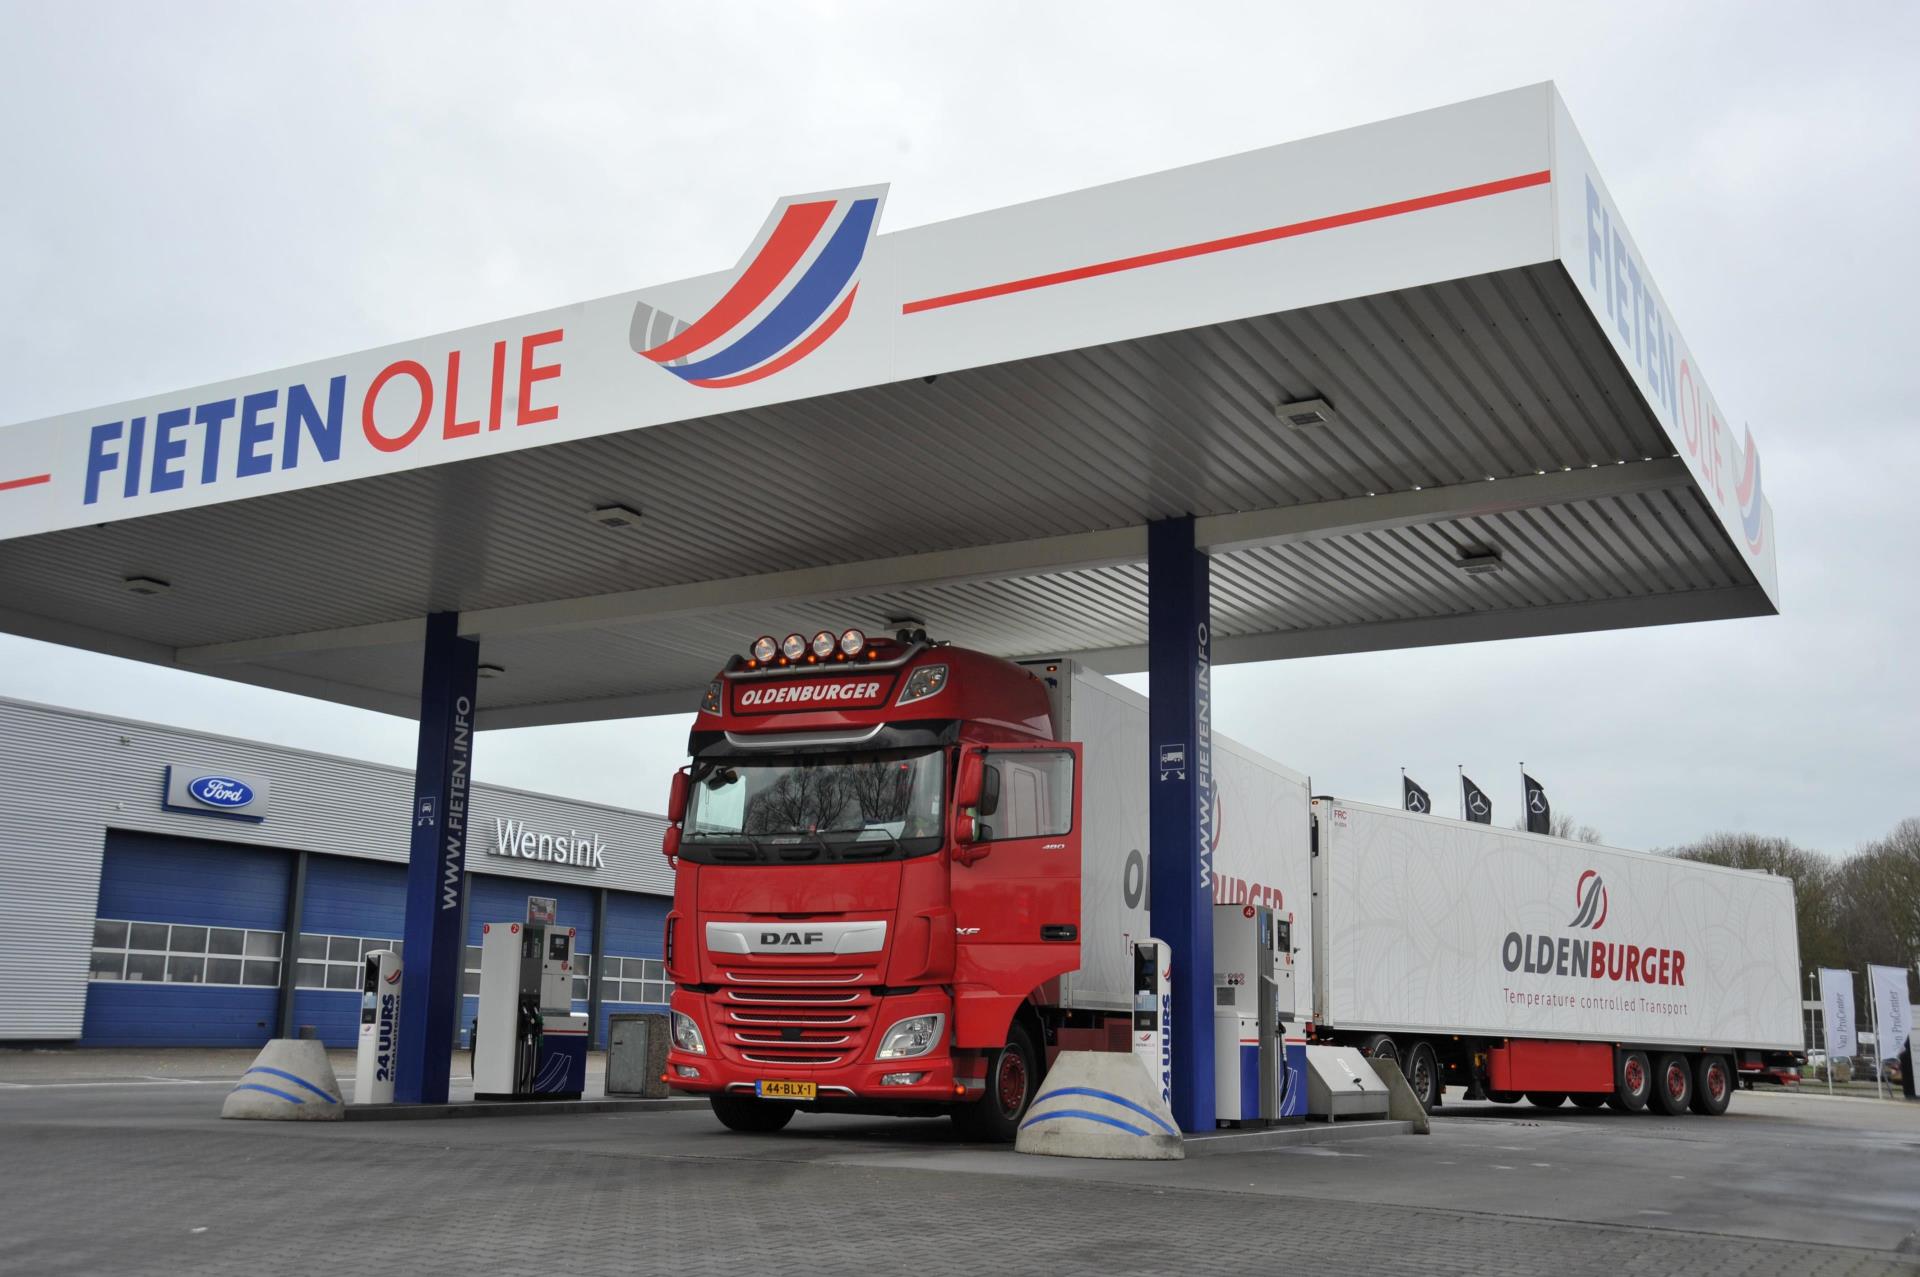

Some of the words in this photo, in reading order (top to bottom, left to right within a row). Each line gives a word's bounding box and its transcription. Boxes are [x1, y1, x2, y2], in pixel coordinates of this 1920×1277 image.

[741, 682, 880, 706] OLDENBURGER
[203, 779, 243, 802] Ford
[442, 696, 470, 909] WWW.FIETEN.INFO
[1334, 809, 1348, 820] FRC
[497, 818, 606, 868] Wensink
[760, 932, 823, 945] DAF
[956, 927, 980, 935] XF
[1502, 931, 1685, 987] OLDENBURGER
[1503, 988, 1576, 1008] Temperature
[1580, 996, 1636, 1012] controlled
[1641, 998, 1688, 1016] Transport
[378, 993, 396, 1052] UURS
[1162, 993, 1171, 1066] UURS
[376, 1054, 390, 1082] 24
[766, 1083, 812, 1095] 44-BLX-1
